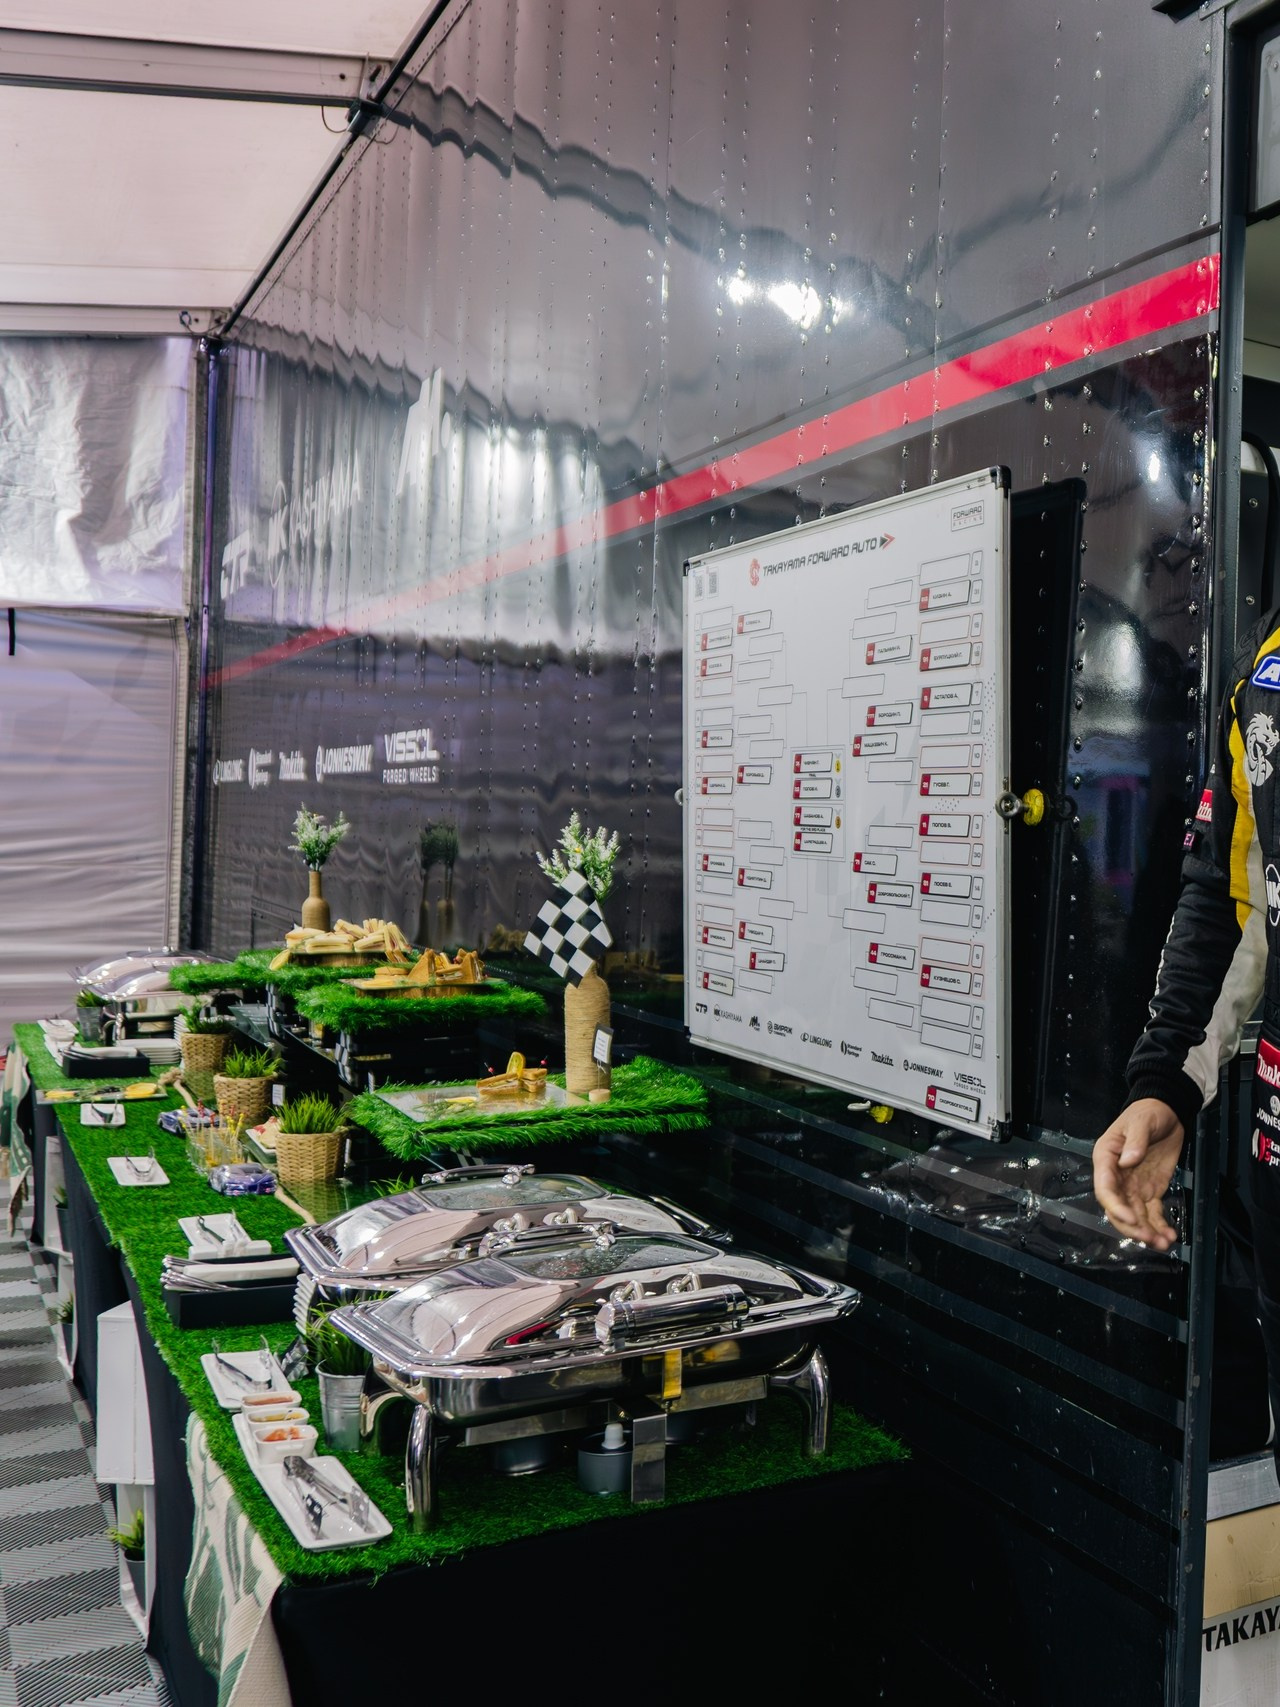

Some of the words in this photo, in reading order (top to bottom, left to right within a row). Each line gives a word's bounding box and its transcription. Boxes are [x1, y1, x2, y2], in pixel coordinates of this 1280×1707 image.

[952, 505, 983, 519] FORWARD
[762, 555, 806, 577] TAKAYAMA
[807, 544, 850, 567] FORWARD
[851, 537, 878, 556] AUTO
[384, 728, 438, 762] VISSOL
[383, 768, 408, 783] FORGED
[409, 765, 437, 783] WHEELS
[809, 1035, 833, 1048] LINGLONG
[953, 1072, 987, 1088] VISSOL
